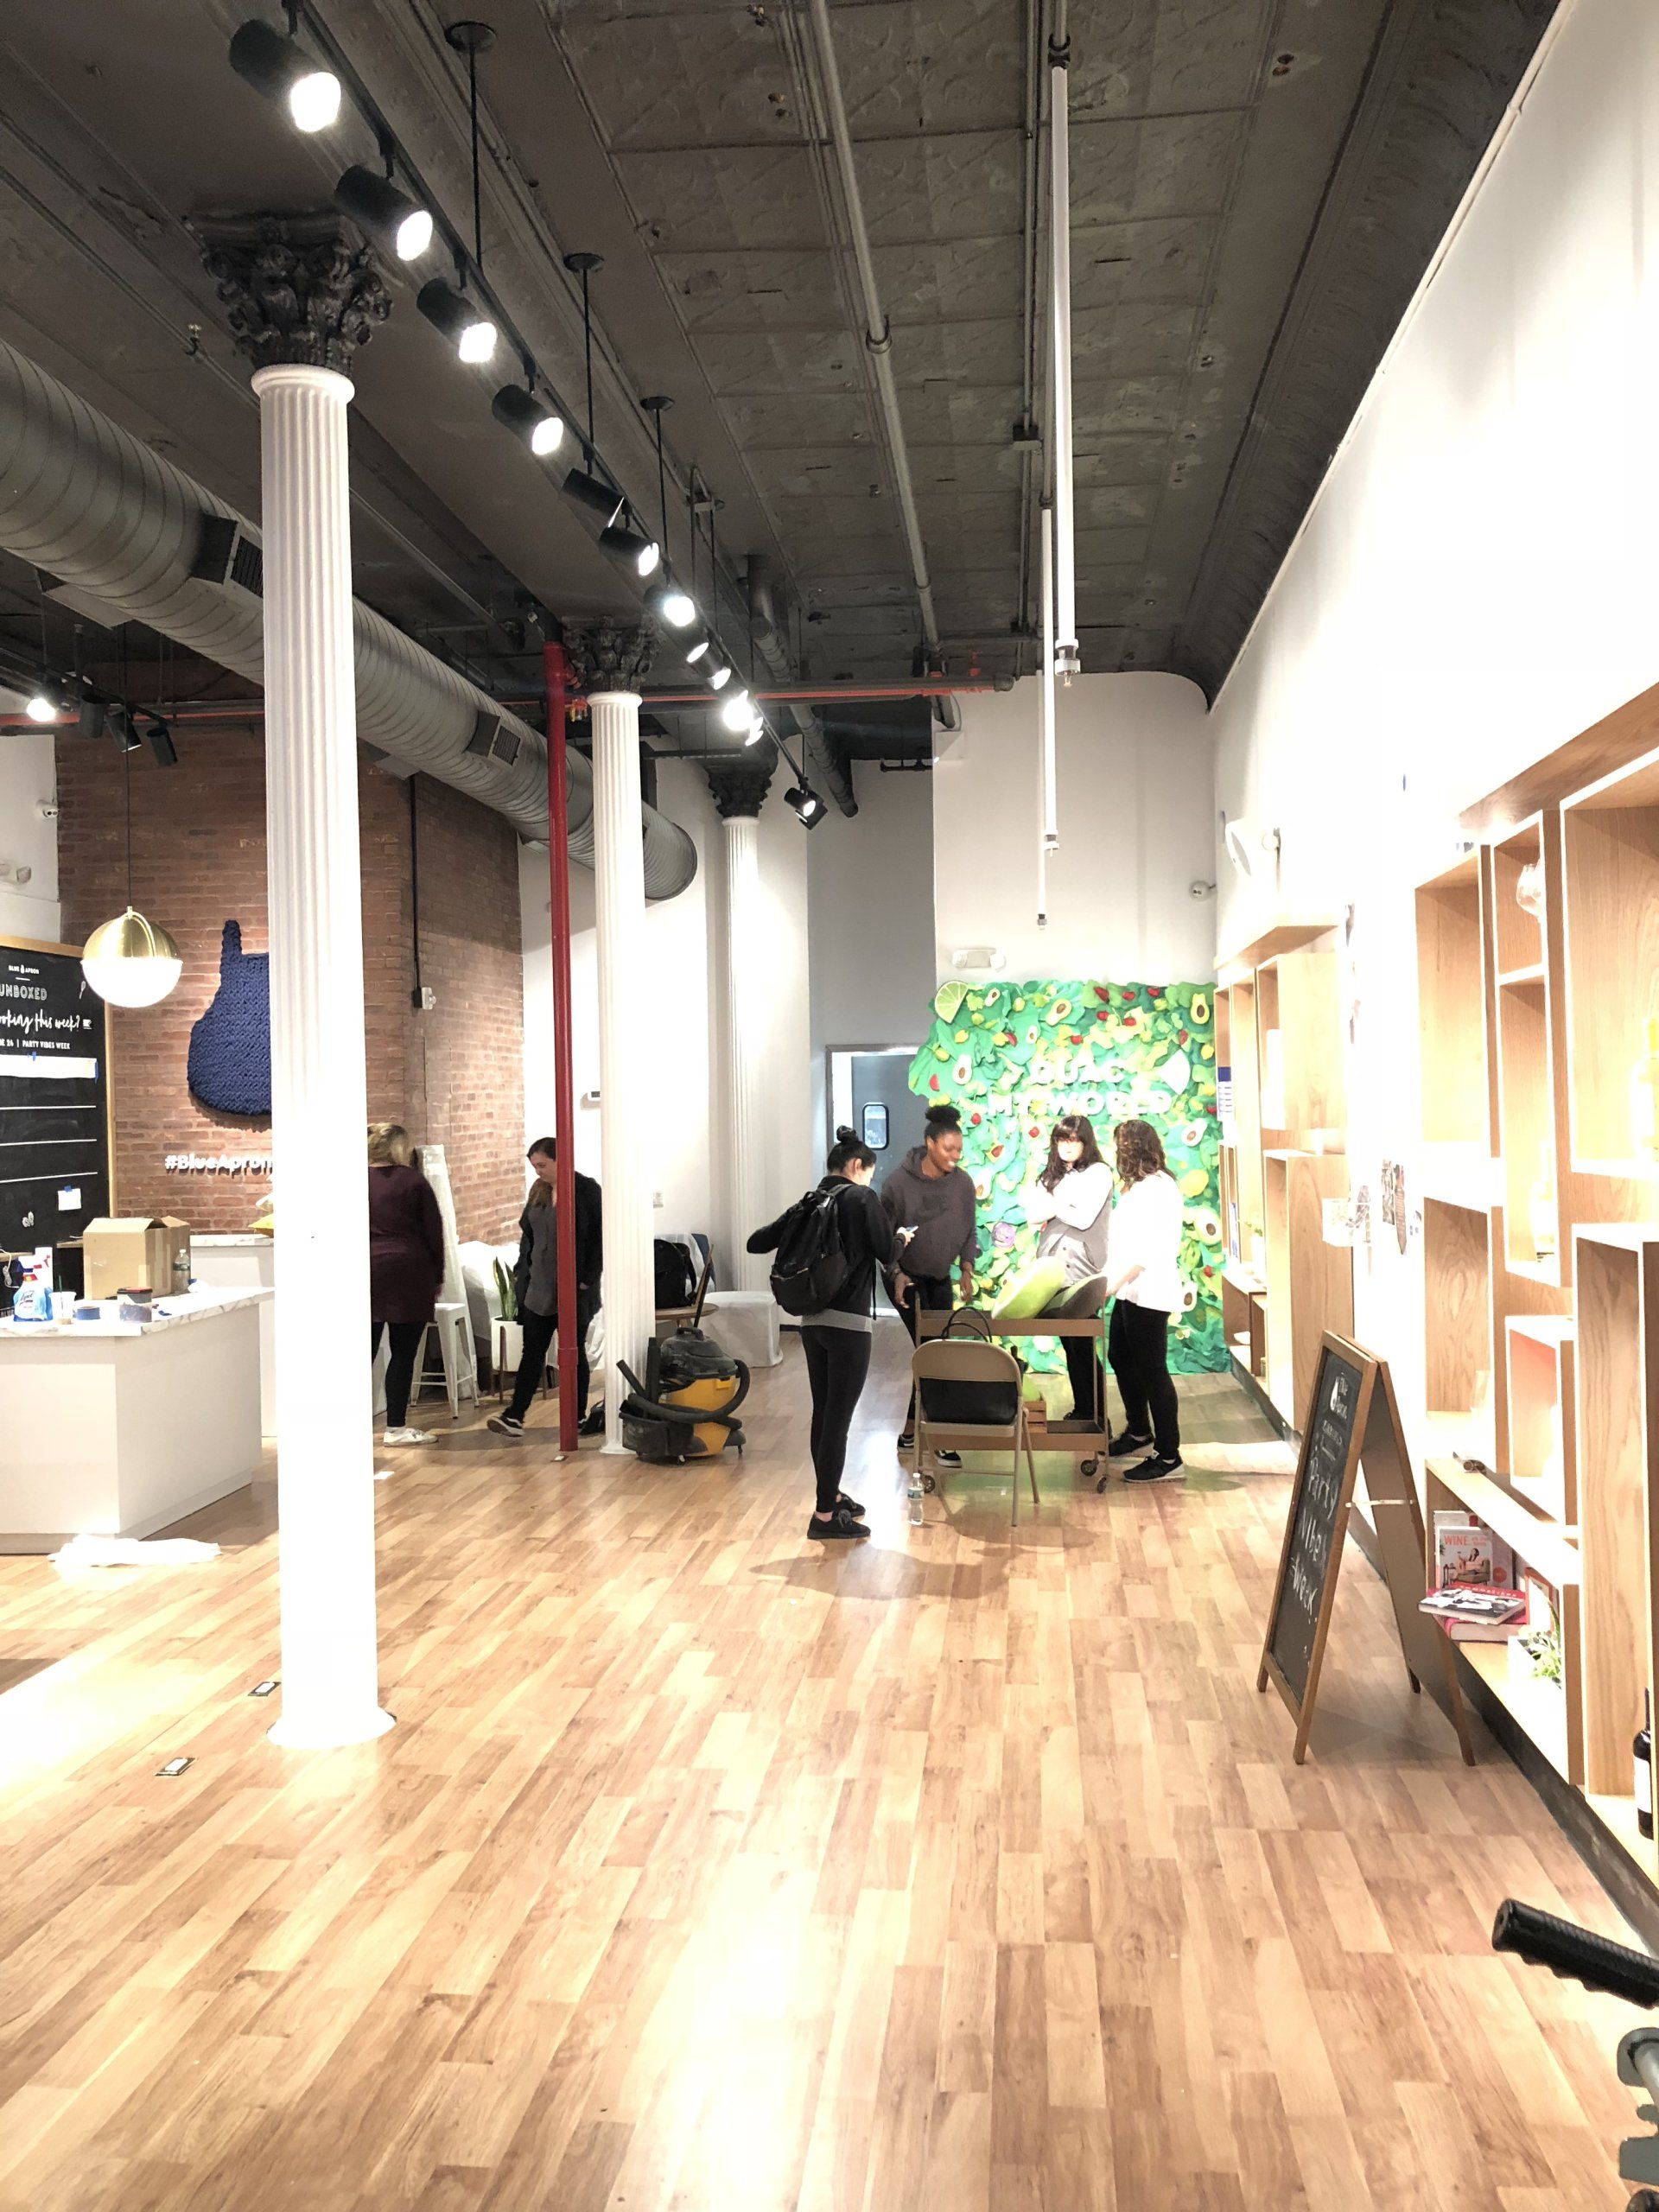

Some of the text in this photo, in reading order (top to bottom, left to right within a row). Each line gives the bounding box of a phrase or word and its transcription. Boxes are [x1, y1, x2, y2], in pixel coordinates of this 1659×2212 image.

[0, 983, 48, 1001] UNBOXED
[35, 1008, 52, 1032] this
[22, 1039, 39, 1048] PARTY
[40, 1040, 54, 1049] VIBES
[1444, 1535, 1468, 1546] WINE
